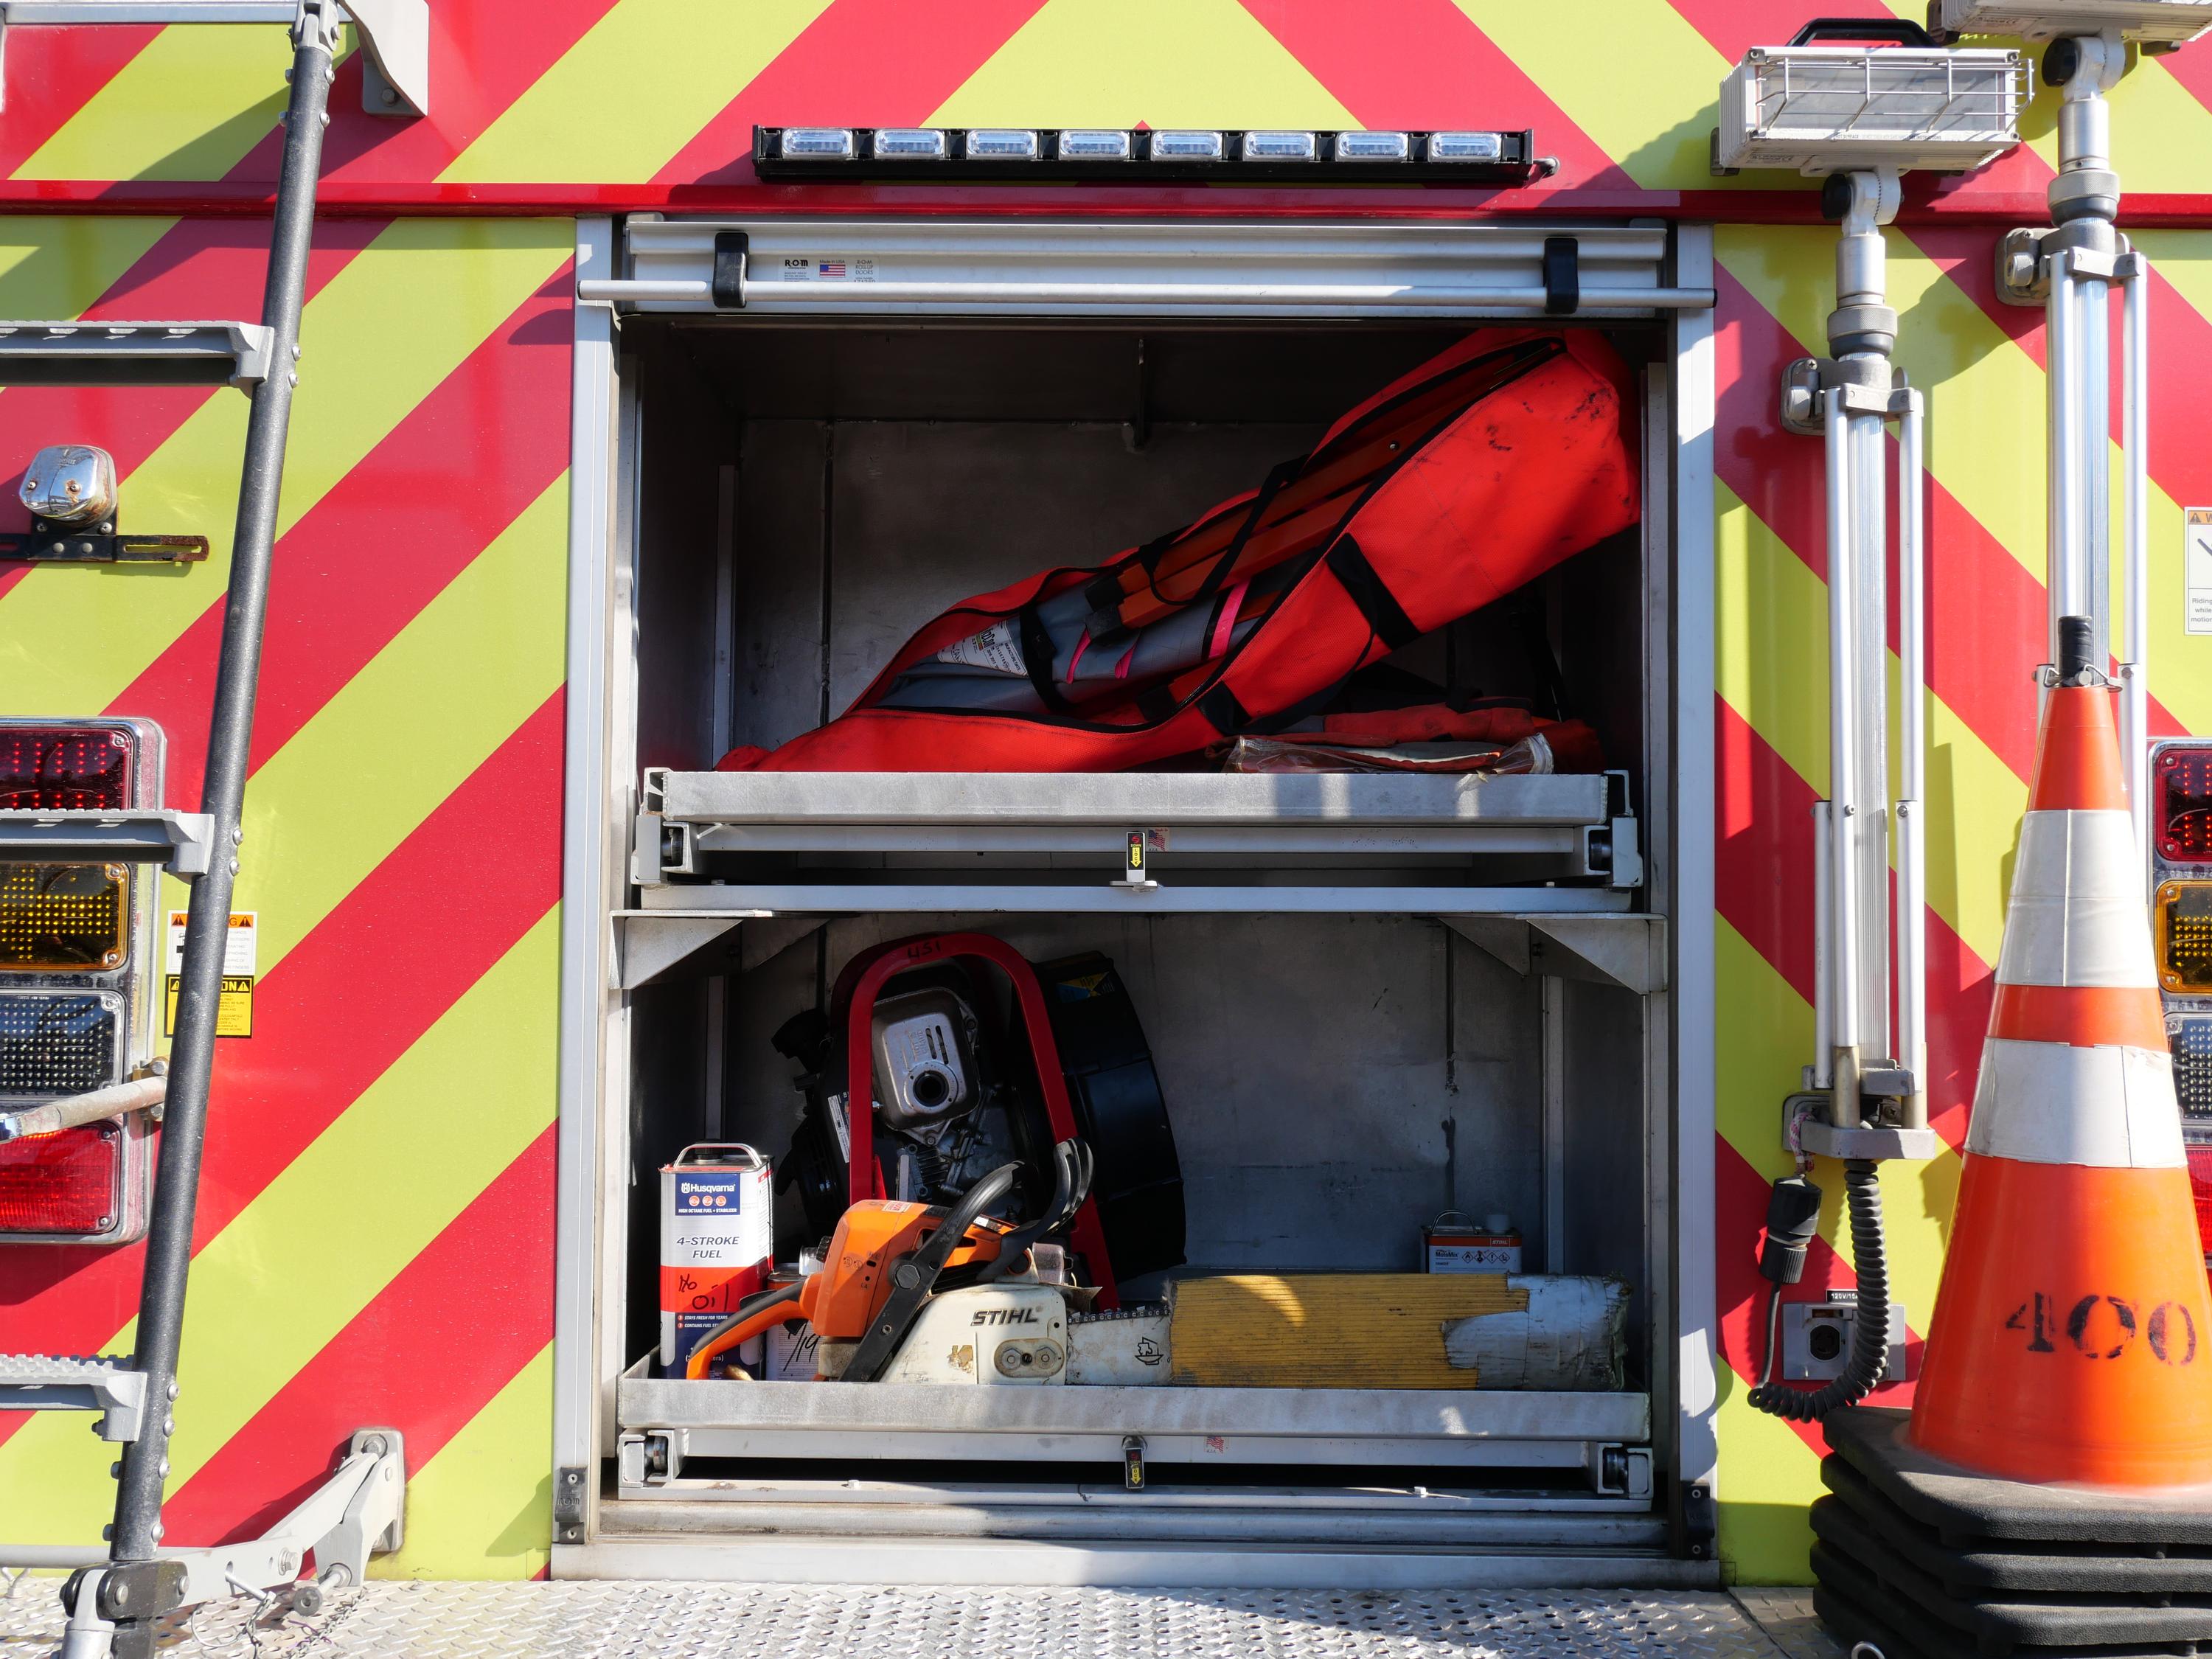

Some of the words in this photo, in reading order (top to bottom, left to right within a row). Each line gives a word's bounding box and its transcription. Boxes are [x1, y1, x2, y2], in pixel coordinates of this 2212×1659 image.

[690, 1183, 735, 1193] Husqvarna
[677, 1237, 740, 1245] 4-STROKE
[692, 1250, 723, 1258] FUEL
[970, 1309, 1039, 1326] STIHL
[2005, 1291, 2197, 1366] 400
